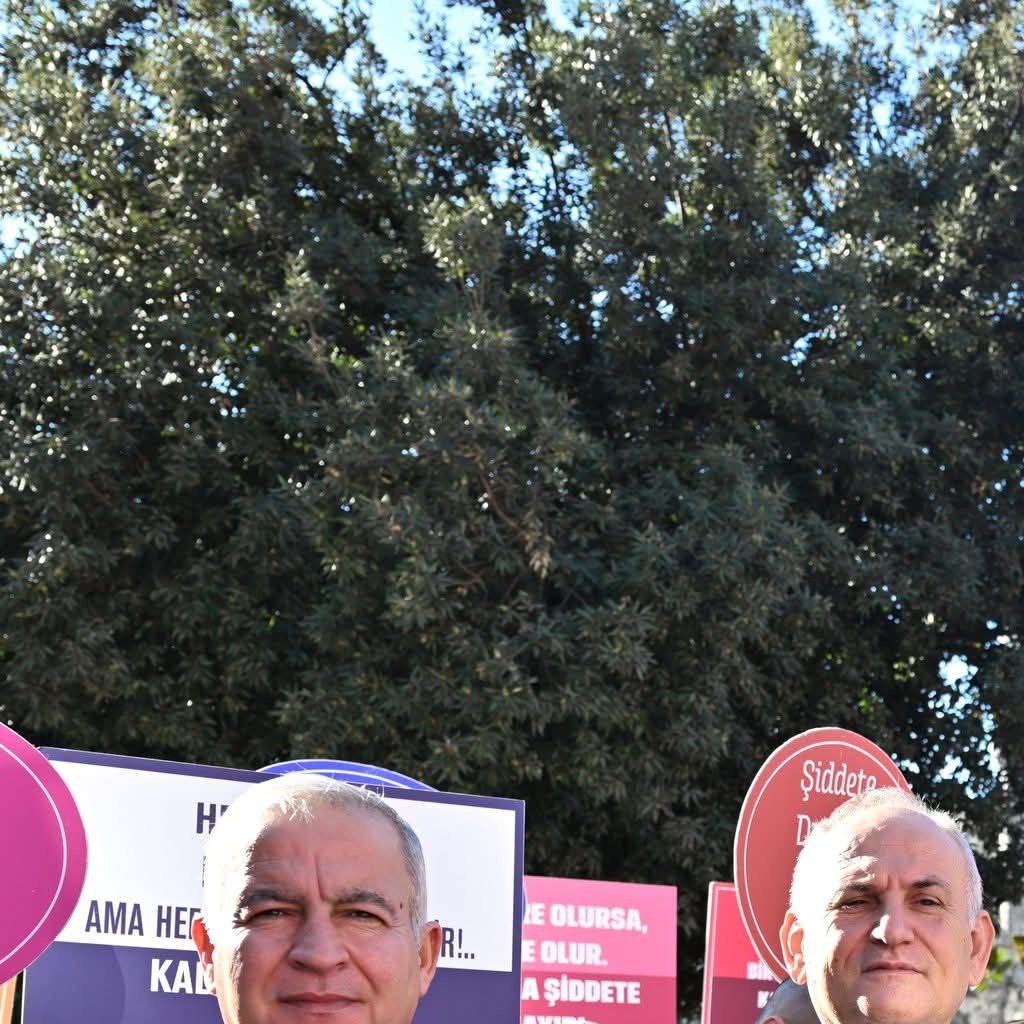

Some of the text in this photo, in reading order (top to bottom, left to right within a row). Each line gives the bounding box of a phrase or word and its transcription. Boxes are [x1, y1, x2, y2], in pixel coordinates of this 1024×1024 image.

[801, 760, 877, 801] Şiddete
[85, 900, 144, 936] AMA
[550, 903, 648, 934] OLURSA,
[541, 941, 608, 966] OLUR.
[544, 974, 641, 1007] ŞİDDETE
